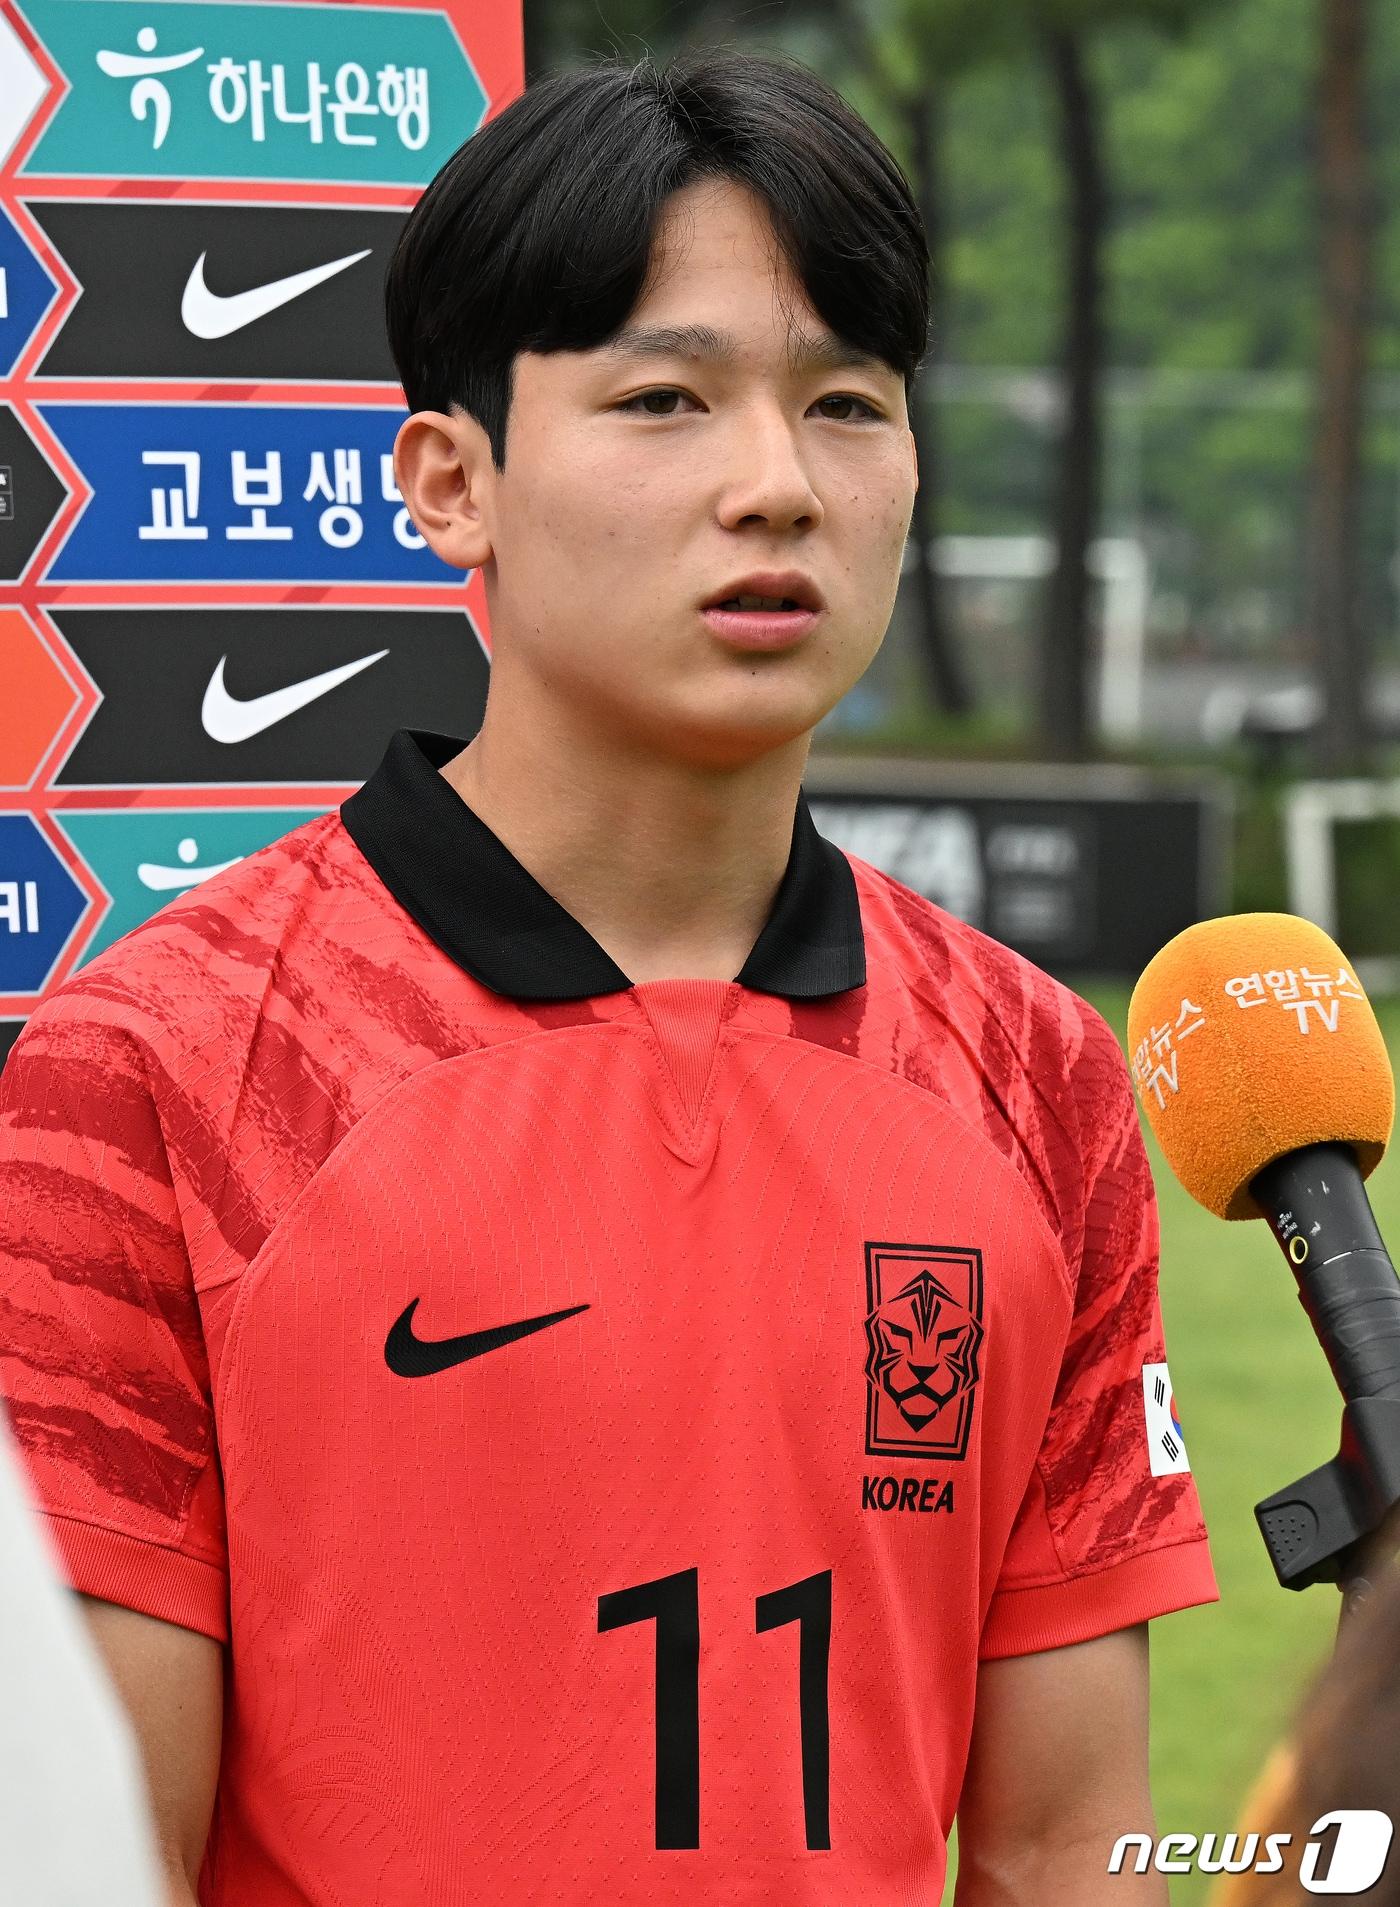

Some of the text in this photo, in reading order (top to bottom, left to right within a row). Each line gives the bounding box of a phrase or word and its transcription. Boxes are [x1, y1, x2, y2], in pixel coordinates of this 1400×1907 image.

[207, 57, 430, 150] 하나은행
[1224, 967, 1363, 1008] 연합뉴스
[1282, 999, 1339, 1035] TV
[1147, 1050, 1180, 1112] TV
[862, 1476, 954, 1513] KOREA
[597, 1567, 832, 1850] 11
